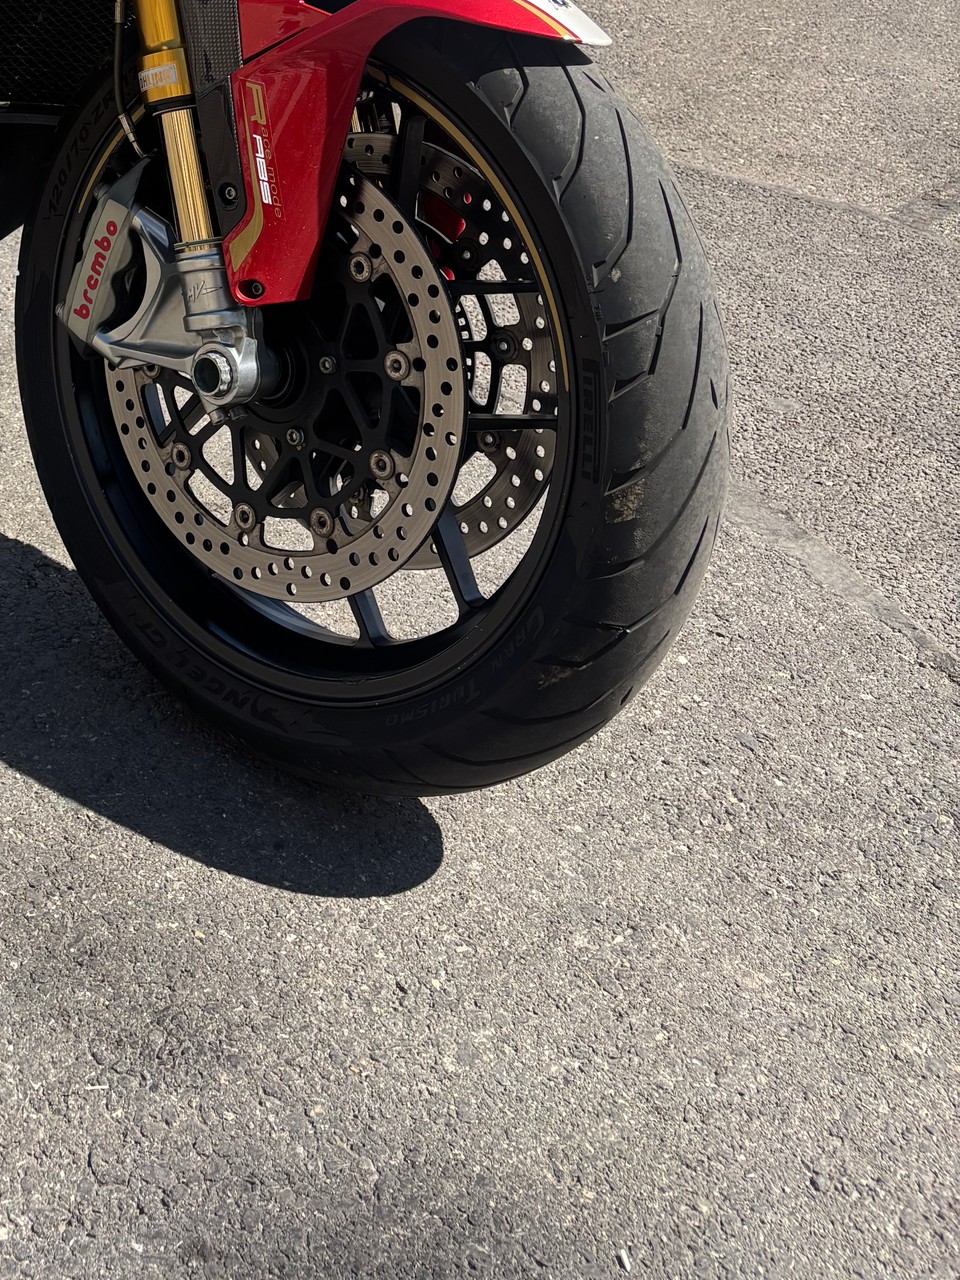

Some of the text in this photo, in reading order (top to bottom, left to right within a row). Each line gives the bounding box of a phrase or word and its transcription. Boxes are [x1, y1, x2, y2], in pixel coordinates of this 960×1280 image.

[252, 133, 272, 206] ABS
[266, 166, 283, 219] mode
[73, 220, 118, 320] brembo
[384, 676, 482, 727] TURISMO
